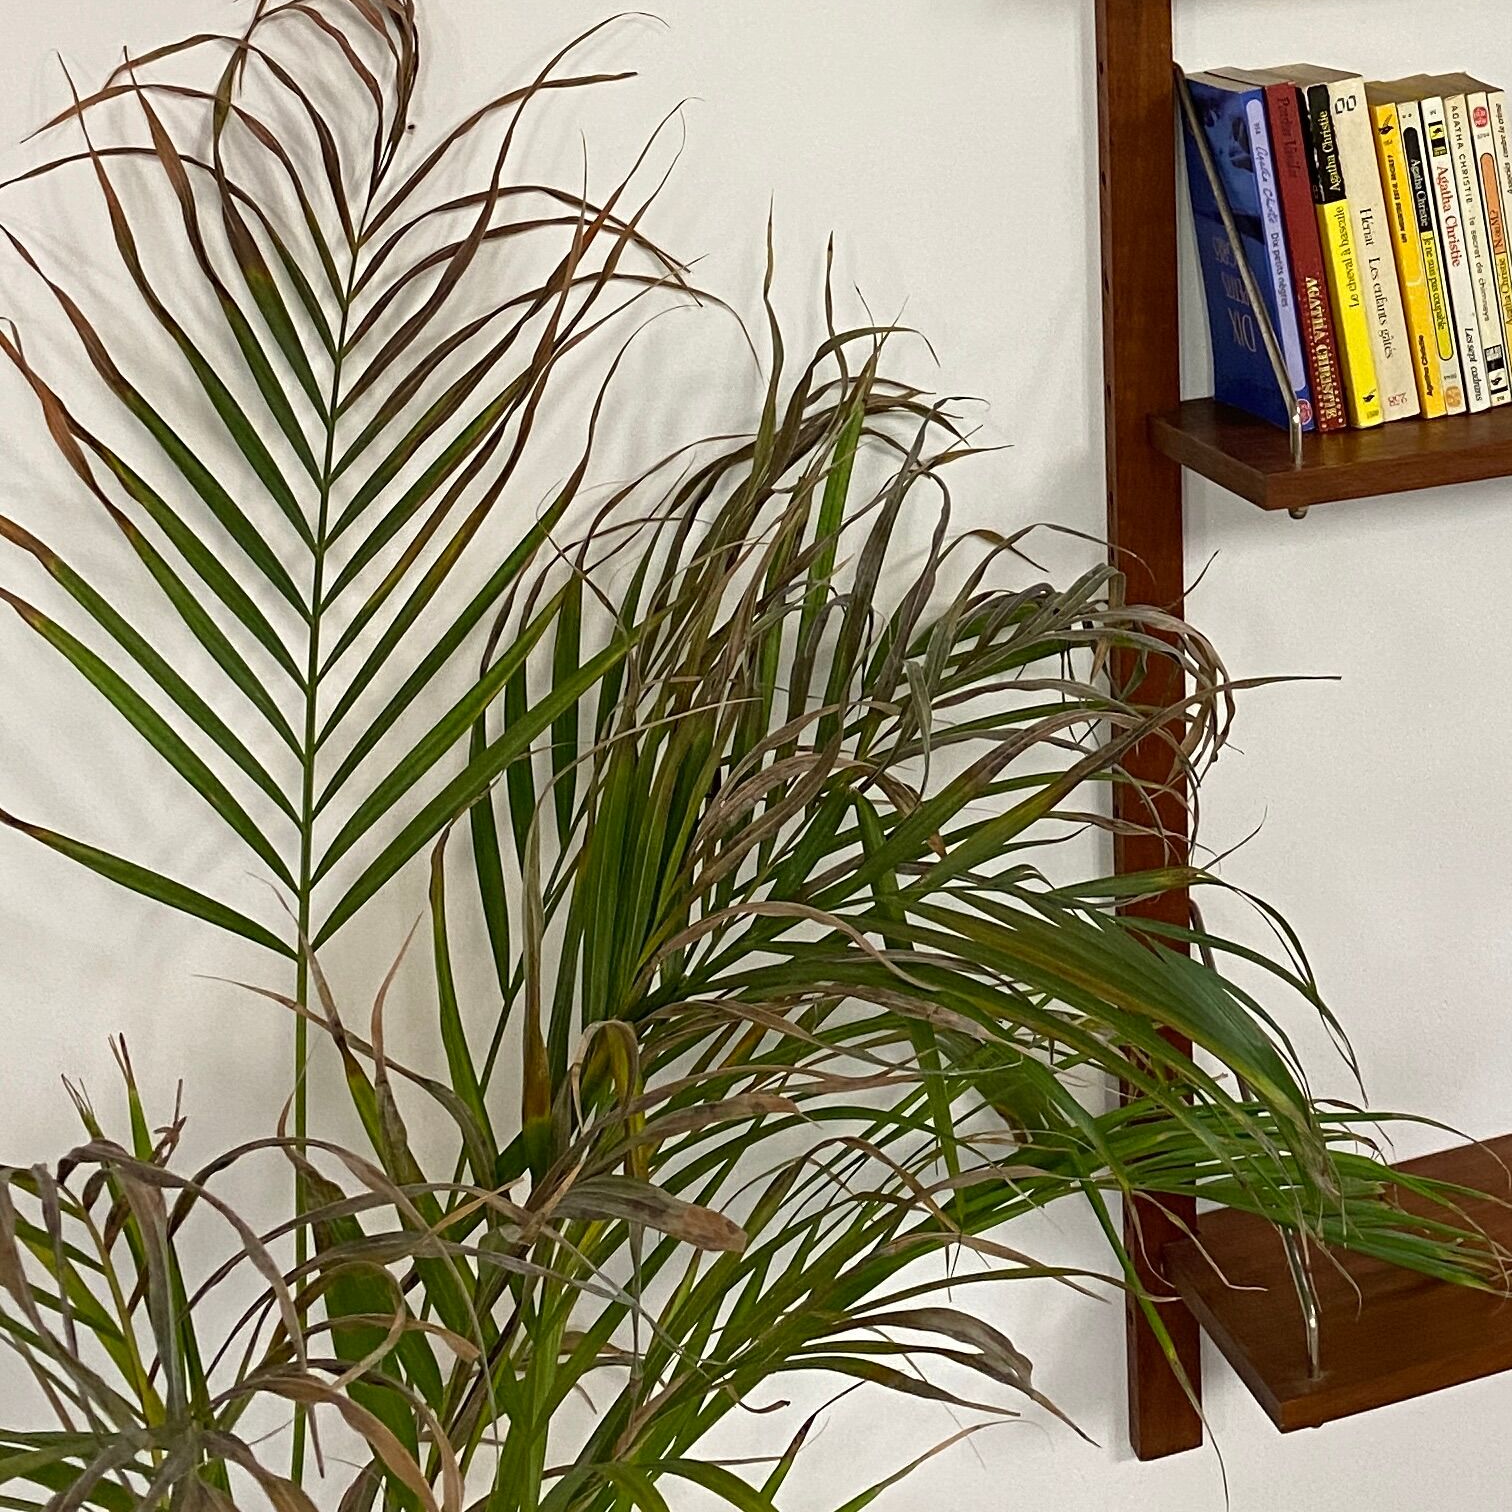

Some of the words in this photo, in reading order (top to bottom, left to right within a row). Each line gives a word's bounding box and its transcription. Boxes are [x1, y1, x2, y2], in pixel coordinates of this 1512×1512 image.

[1317, 110, 1334, 154] Christie
[1451, 105, 1464, 150] AGATHA
[1459, 153, 1473, 204] CHRISTIE
[1325, 154, 1341, 192] Agatha
[1410, 159, 1424, 191] Agatha
[1436, 165, 1454, 213] Agatha
[1415, 191, 1429, 227] Christie
[1469, 216, 1475, 226] le
[1271, 233, 1280, 248] Dix
[1334, 206, 1350, 248] bascule
[1359, 207, 1374, 246] Hériat
[1422, 235, 1431, 246] Je
[1444, 214, 1463, 267] Christie
[1341, 247, 1352, 256] à
[1424, 246, 1432, 258] ne
[1471, 230, 1481, 260] secret
[1272, 250, 1284, 276] petits
[1342, 259, 1359, 291] cheval
[1368, 256, 1381, 281] Les
[1426, 259, 1435, 274] suis
[1476, 262, 1483, 274] de
[1497, 258, 1511, 294] Christie
[1279, 277, 1288, 308] nègres
[1428, 277, 1440, 292] pas
[1478, 277, 1490, 322] chimneys
[1349, 294, 1360, 308] Le
[1373, 282, 1388, 326] enfants
[1431, 292, 1446, 331] coupable
[1305, 276, 1325, 343] AGATHA
[1316, 344, 1338, 420] CHRISTIE
[1378, 329, 1396, 359] gâtés
[1464, 328, 1474, 342] Les
[1467, 343, 1477, 363] sept
[1471, 365, 1483, 402] cadrans
